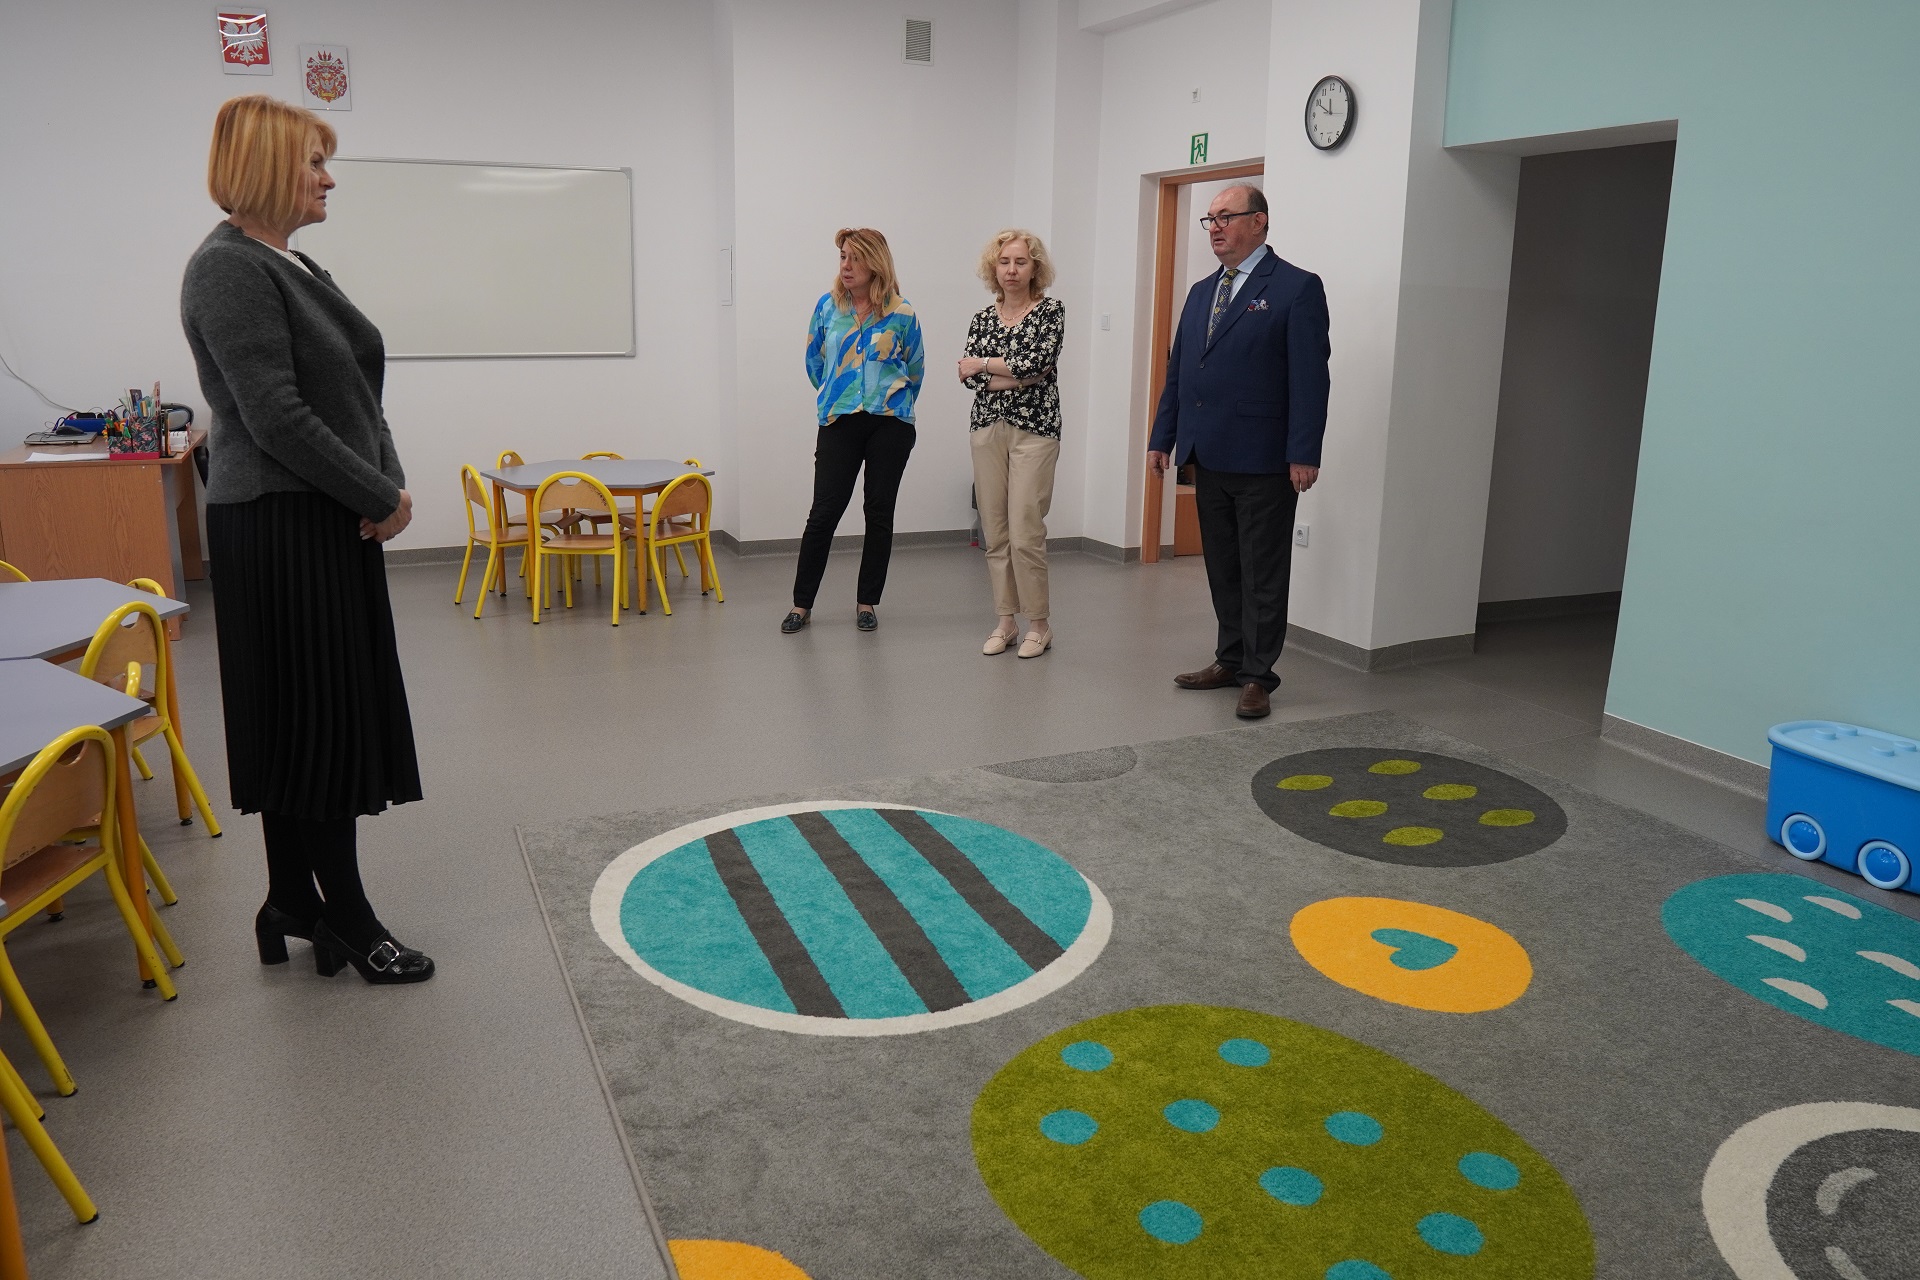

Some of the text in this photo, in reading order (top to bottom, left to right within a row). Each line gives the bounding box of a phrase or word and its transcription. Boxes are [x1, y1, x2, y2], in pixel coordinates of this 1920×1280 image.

[1329, 82, 1335, 91] 12
[1339, 85, 1342, 93] 1
[1322, 88, 1327, 96] 11
[1320, 132, 1324, 140] 7
[1336, 130, 1340, 139] 5
